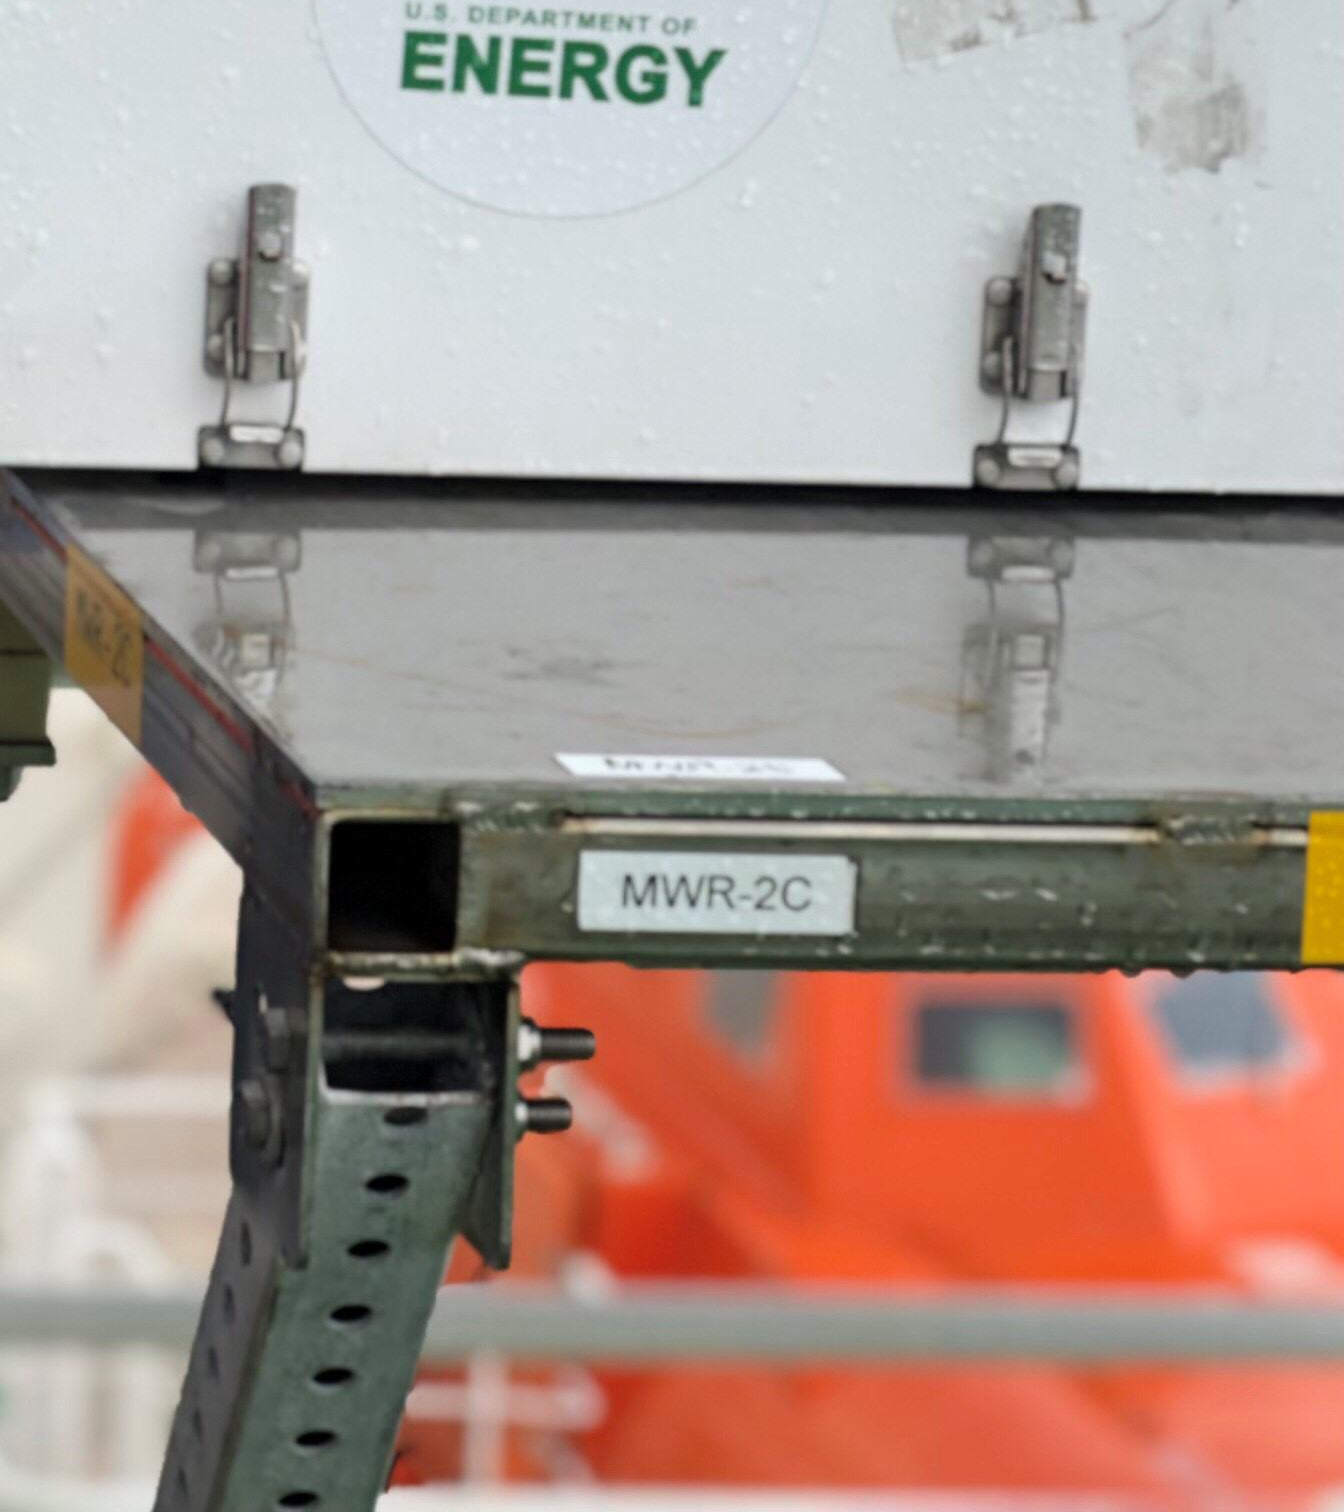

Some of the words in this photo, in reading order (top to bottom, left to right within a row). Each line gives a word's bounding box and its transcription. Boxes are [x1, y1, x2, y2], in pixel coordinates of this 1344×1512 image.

[405, 1, 457, 22] U.S.
[467, 4, 651, 34] DEPARTMENT
[661, 17, 698, 36] OF
[400, 30, 727, 107] ENERGY
[621, 874, 813, 912] MWR-2C
